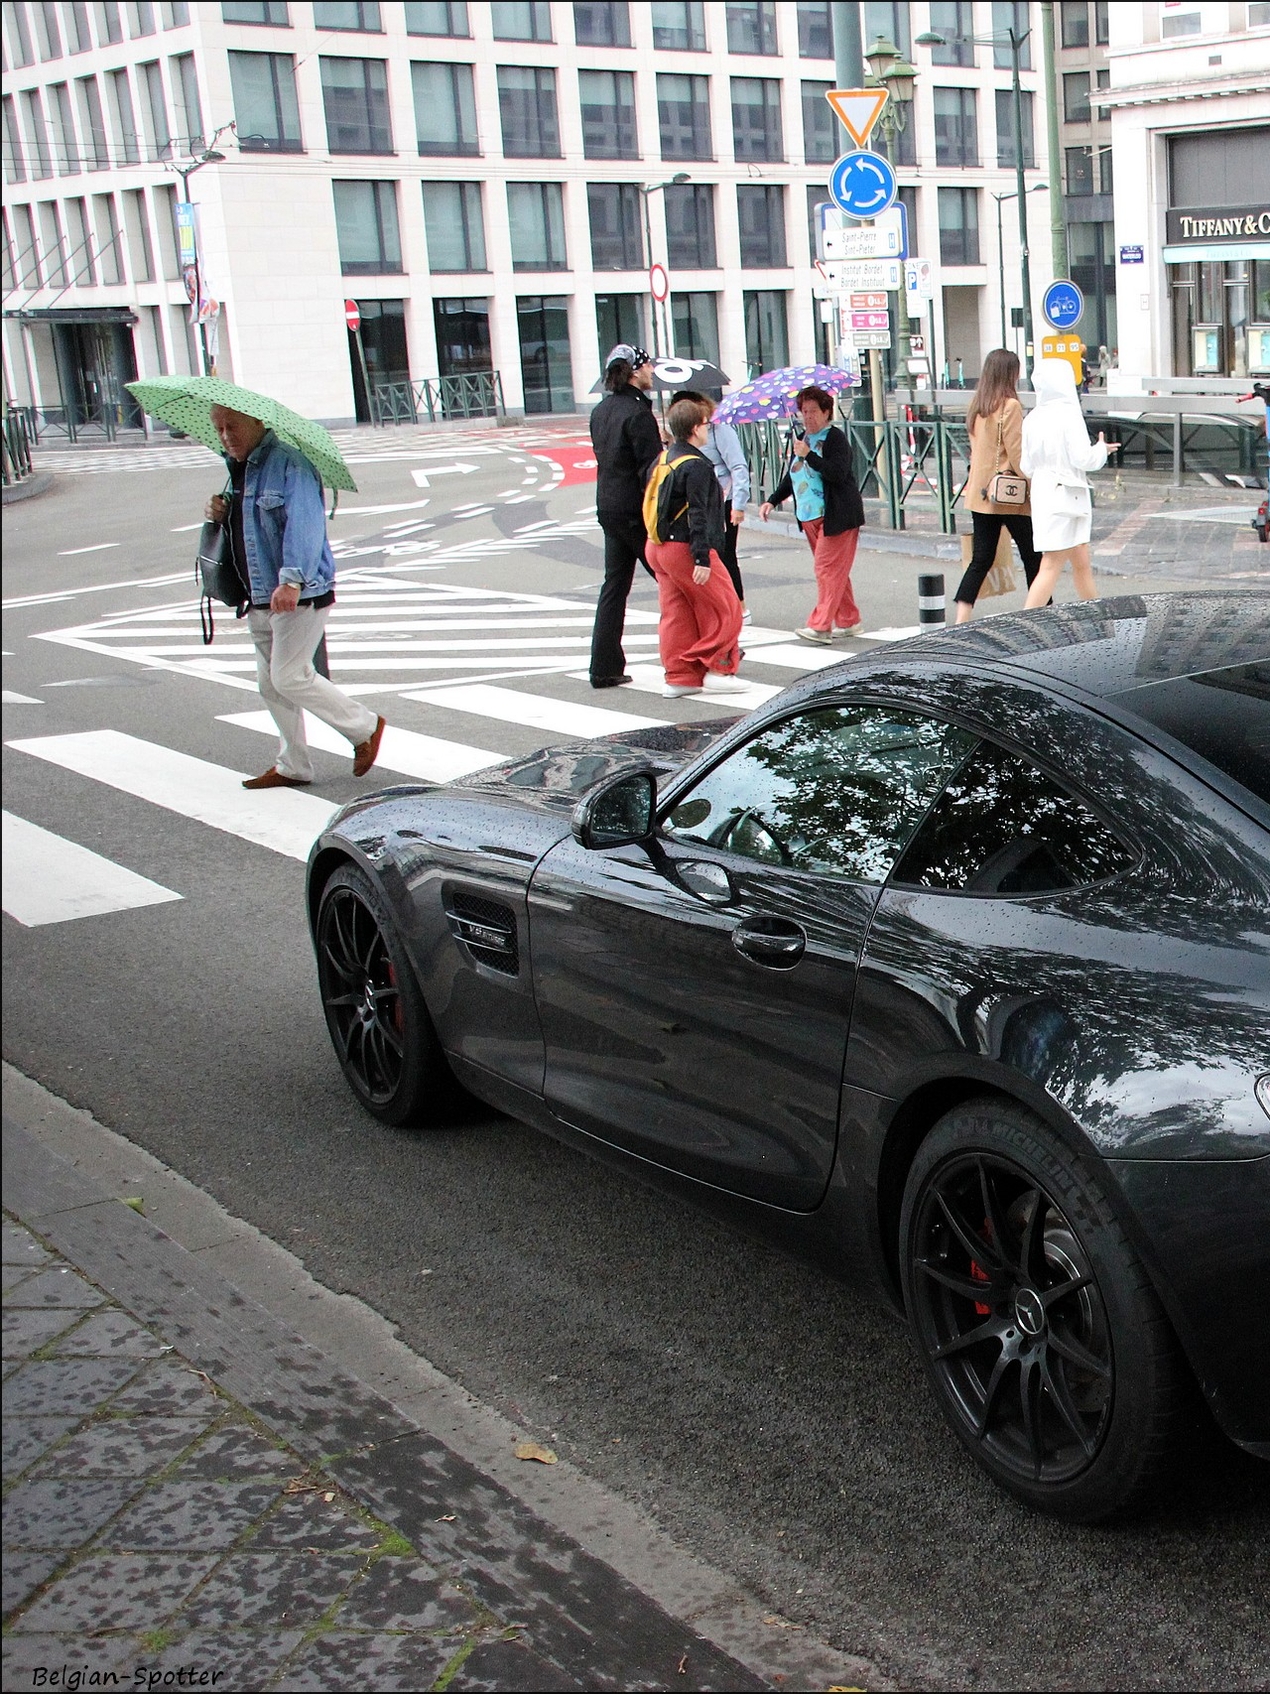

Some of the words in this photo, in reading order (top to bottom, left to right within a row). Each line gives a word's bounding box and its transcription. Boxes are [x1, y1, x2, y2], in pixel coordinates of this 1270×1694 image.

[842, 231, 877, 243] Saint-Pierre
[841, 264, 862, 275] Institut
[864, 264, 883, 274] Bordet
[840, 277, 860, 288] Bordet
